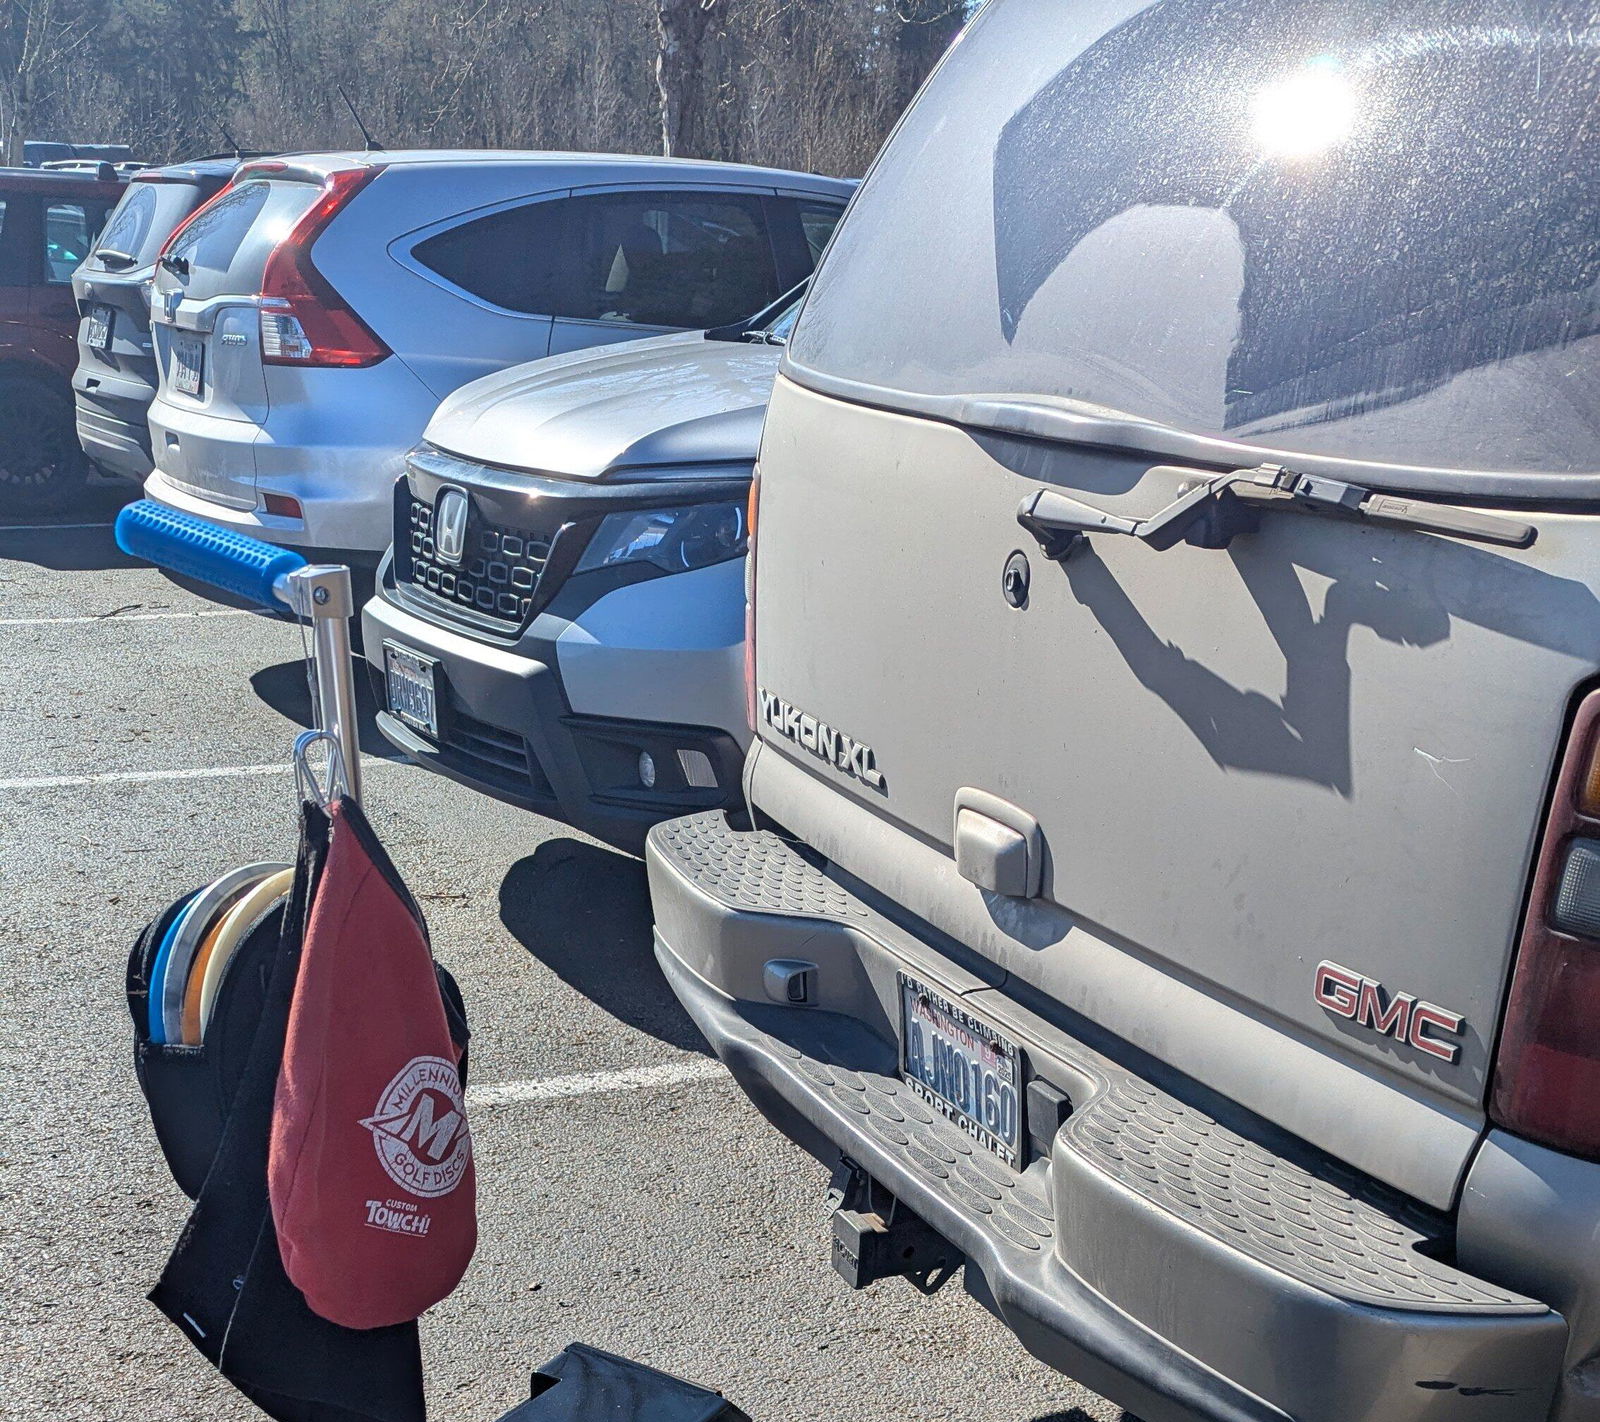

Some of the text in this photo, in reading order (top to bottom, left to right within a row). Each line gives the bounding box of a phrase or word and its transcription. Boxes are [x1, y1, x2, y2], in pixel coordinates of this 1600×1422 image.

[758, 687, 885, 790] YUKON XL
[909, 995, 975, 1051] WASHINGTON
[916, 982, 949, 1014] RATHER
[952, 1005, 965, 1024] BE
[967, 1016, 1014, 1057] CLIMBING
[1313, 959, 1465, 1062] GMC
[392, 1068, 465, 1111] MILLENNIU
[906, 1018, 1016, 1148] AJN0160
[394, 1149, 465, 1187] GOLF DISCS
[365, 1200, 432, 1235] TOWCH!
[385, 1198, 419, 1213] CUSTOM
